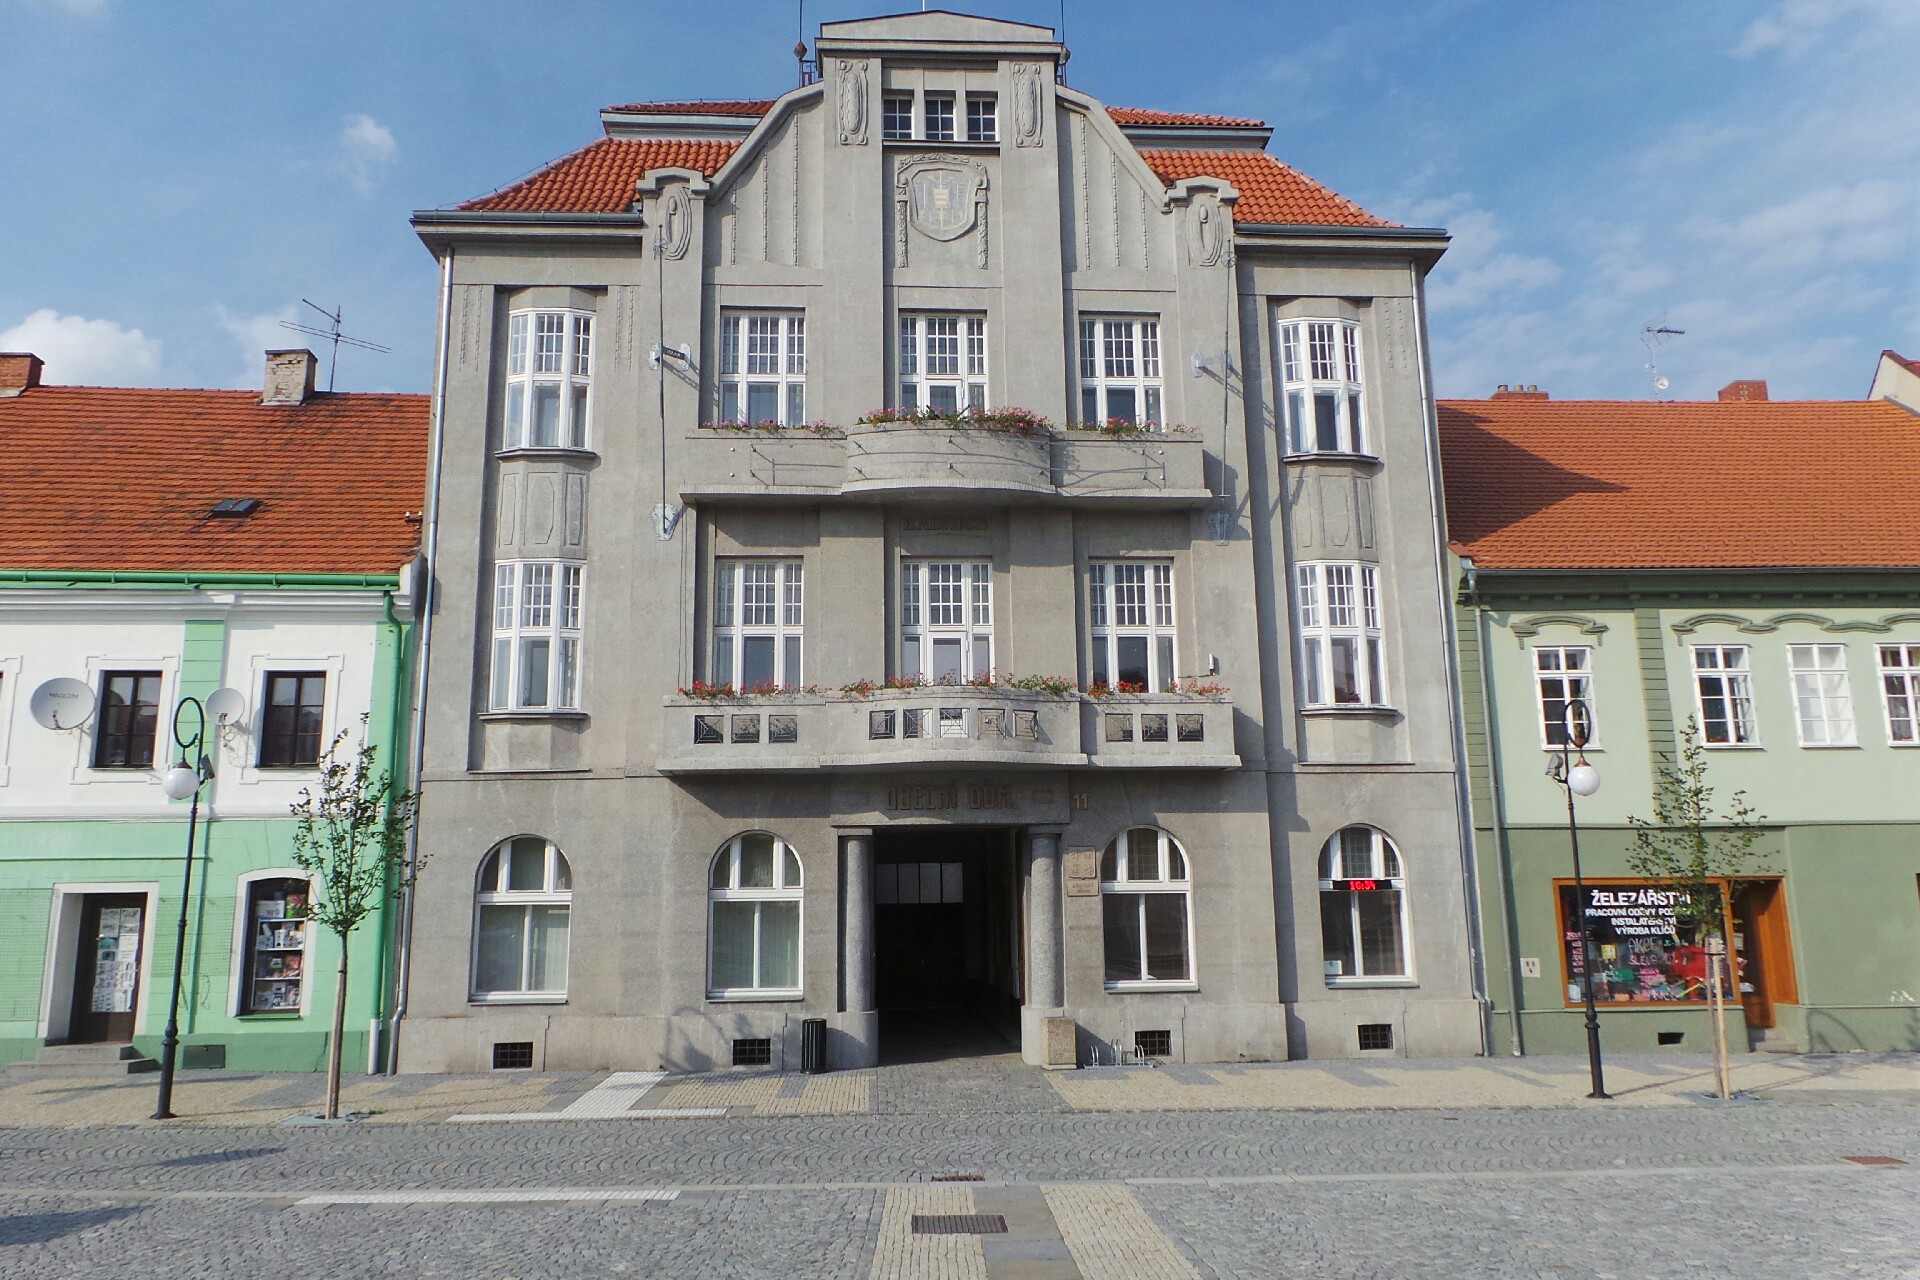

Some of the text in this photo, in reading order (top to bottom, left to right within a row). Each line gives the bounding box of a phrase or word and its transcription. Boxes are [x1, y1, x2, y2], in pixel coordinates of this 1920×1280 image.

[1073, 792, 1089, 810] 11
[1585, 907, 1627, 917] PRACOVNÍ
[1615, 925, 1650, 935] VÝROBA
